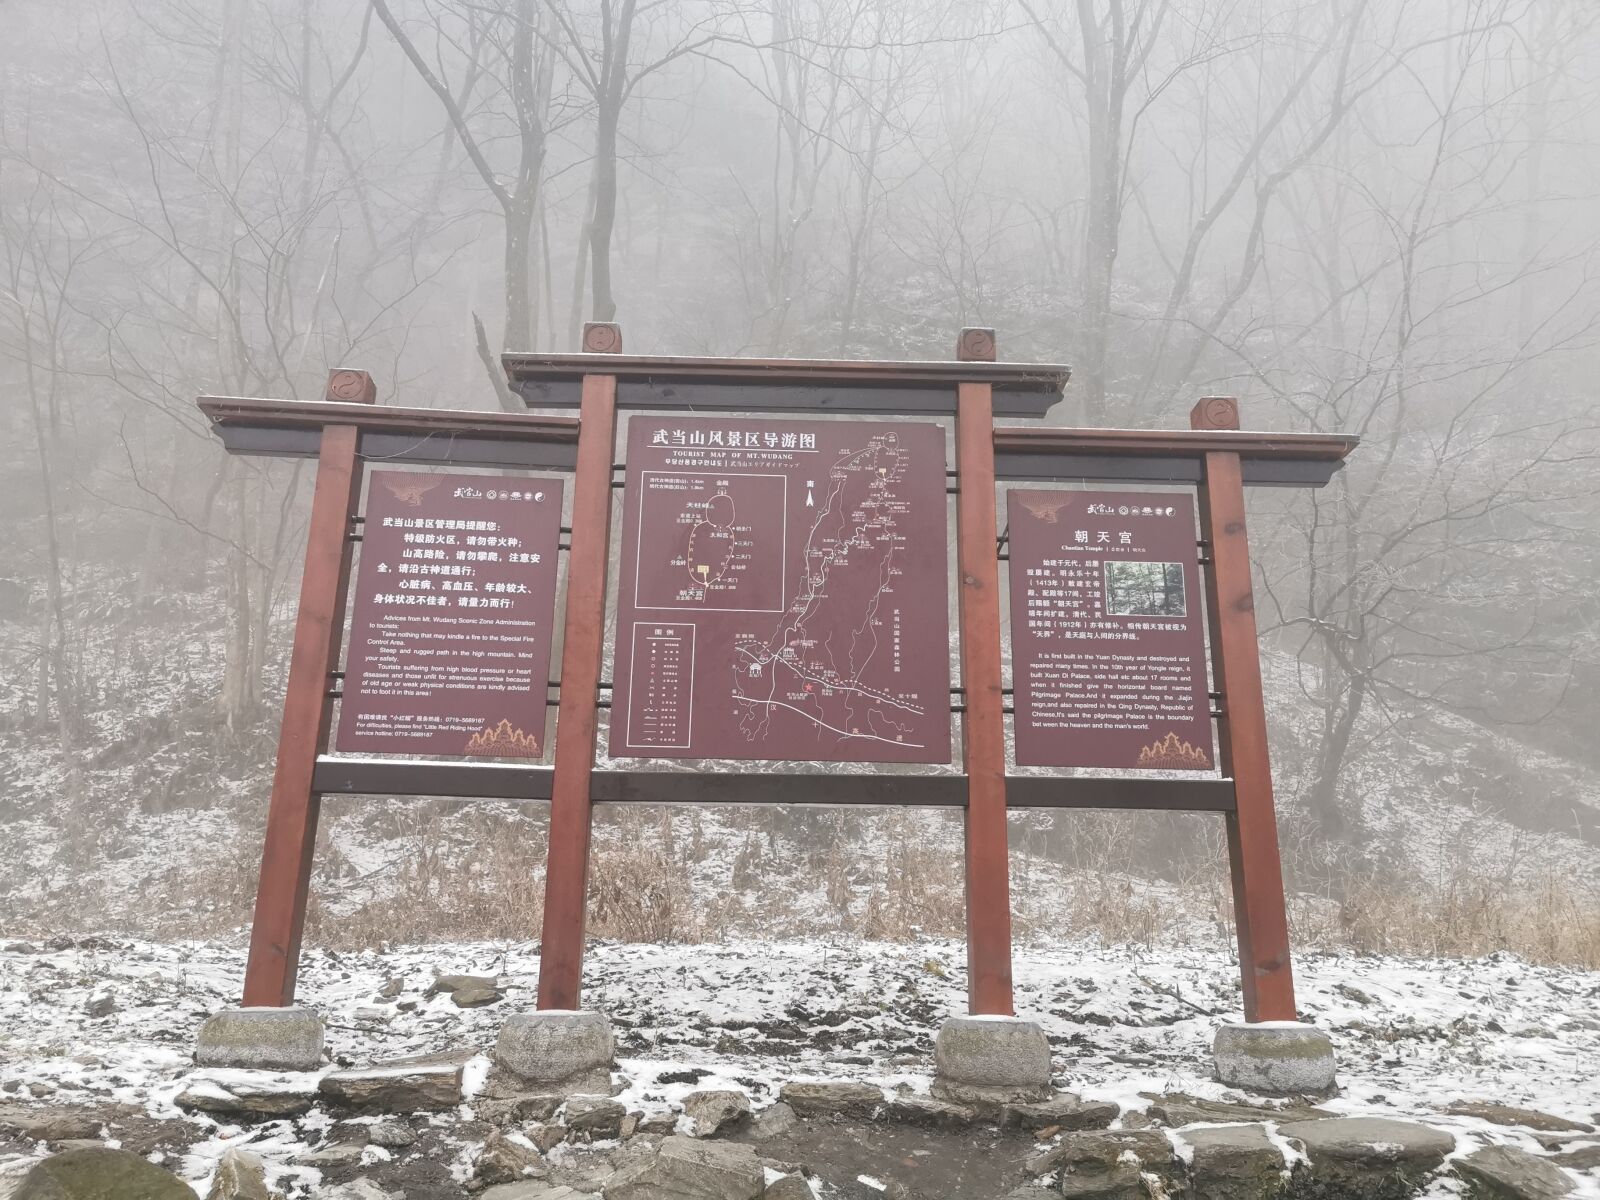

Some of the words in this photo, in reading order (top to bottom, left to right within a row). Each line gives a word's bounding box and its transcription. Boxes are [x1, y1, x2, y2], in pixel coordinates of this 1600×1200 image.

[653, 429, 816, 449] 武当山风景区导游图
[1074, 530, 1132, 544] 朝天宫
